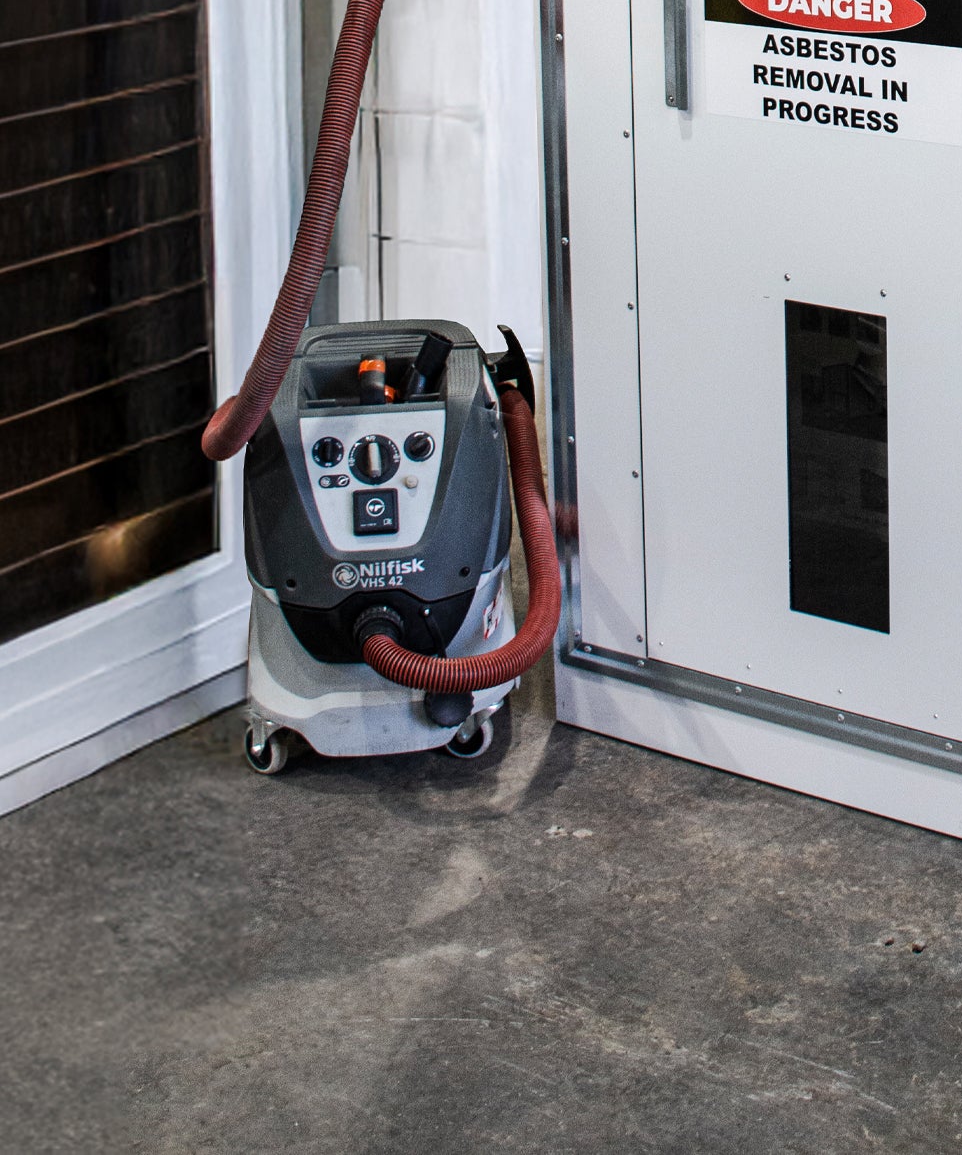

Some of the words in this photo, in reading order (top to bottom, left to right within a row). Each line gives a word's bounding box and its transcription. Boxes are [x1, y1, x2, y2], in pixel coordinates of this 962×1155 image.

[762, 34, 897, 67] ASBESTOS
[753, 64, 873, 98] REMOVAL
[882, 79, 908, 102] IN
[763, 97, 899, 133] PROGRESS
[360, 558, 425, 577] Nilfisk
[360, 577, 385, 588] VHS
[388, 576, 403, 586] 42
